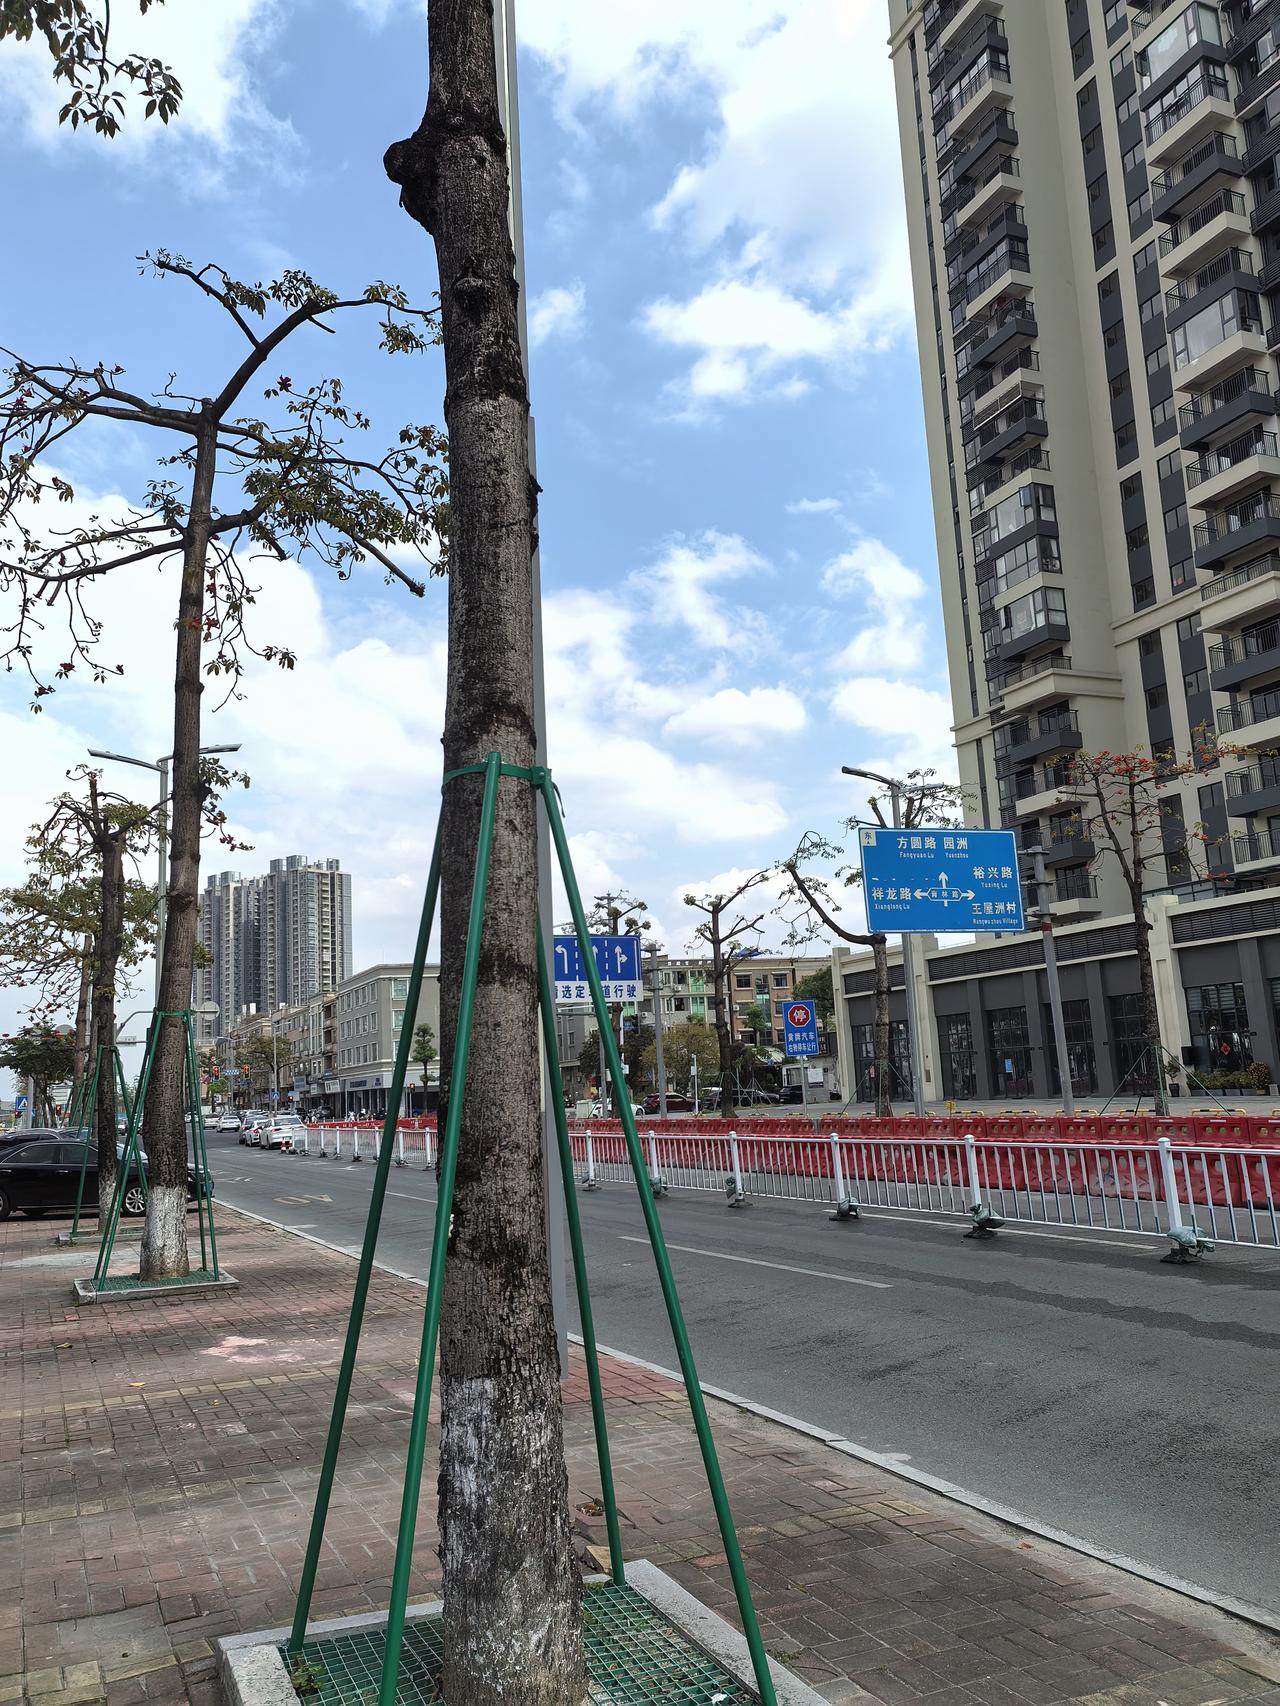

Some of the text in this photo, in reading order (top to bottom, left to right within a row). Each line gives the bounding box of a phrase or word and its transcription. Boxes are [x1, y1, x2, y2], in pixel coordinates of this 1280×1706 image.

[897, 836, 968, 850] 方圆路 园洲
[899, 851, 927, 859] Fangyuan
[973, 866, 1013, 879] 裕兴路
[872, 887, 912, 901] 祥龙路
[875, 903, 902, 911] Xianglong
[971, 901, 1017, 915] 王屋洲村
[555, 984, 637, 999] 选定道行驶
[793, 1009, 806, 1022] 停
